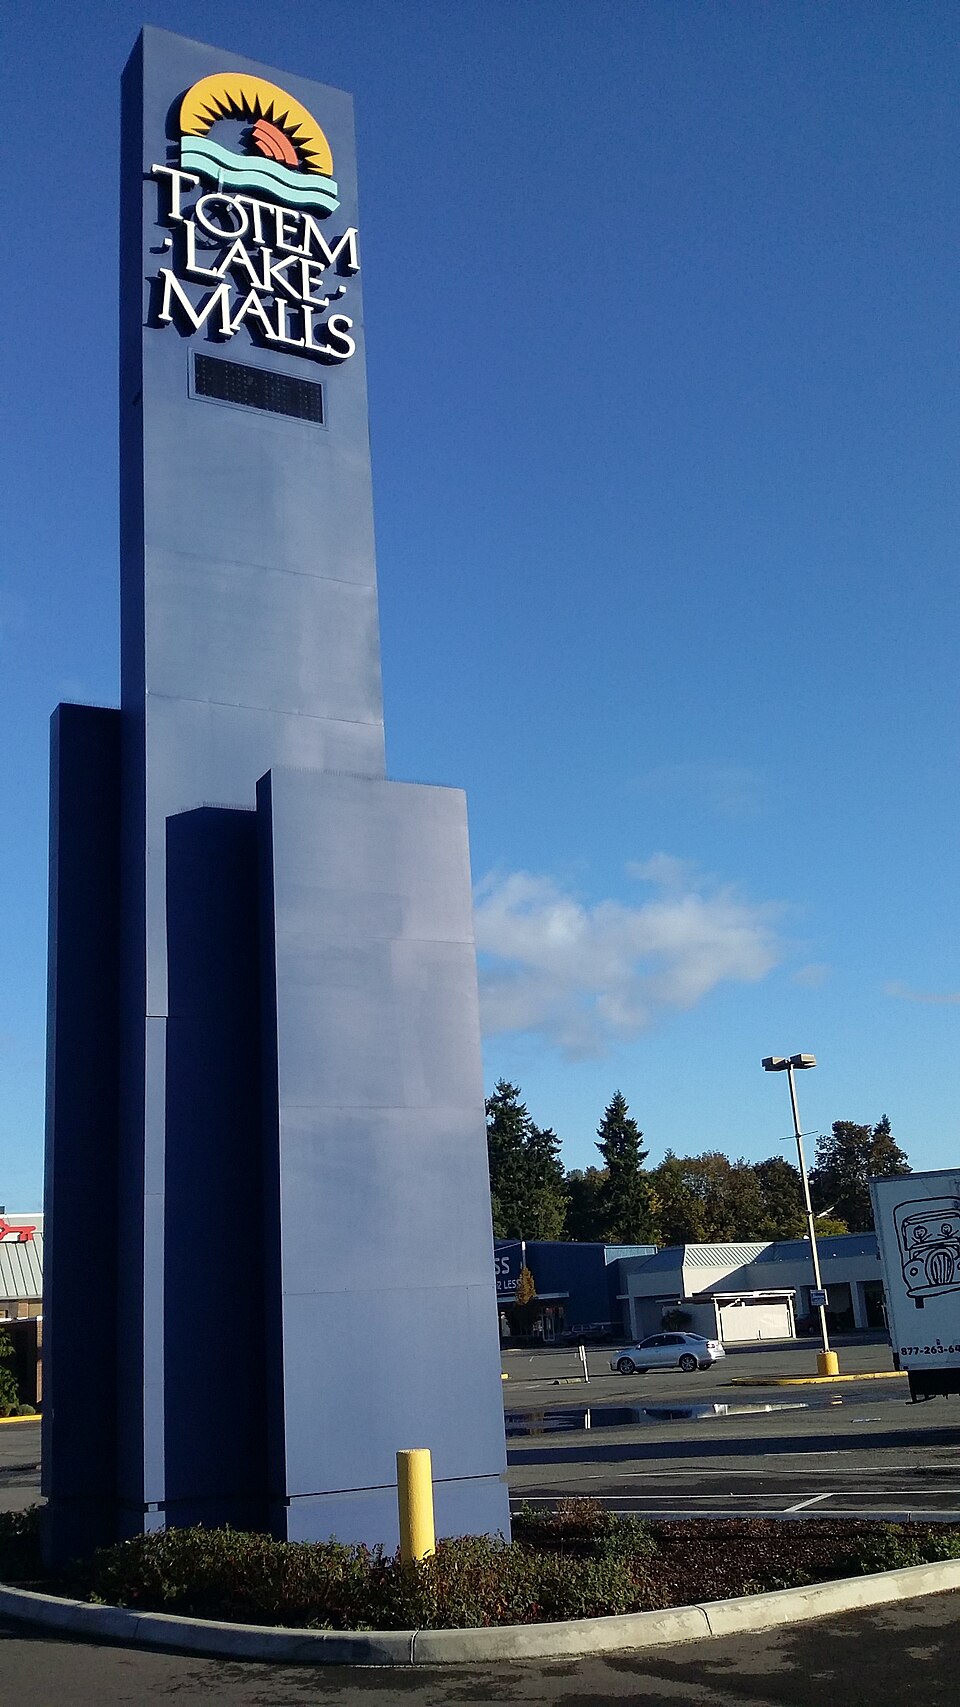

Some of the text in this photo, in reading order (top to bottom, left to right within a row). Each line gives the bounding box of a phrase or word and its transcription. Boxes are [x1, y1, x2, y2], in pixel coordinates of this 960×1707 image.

[152, 164, 360, 270] TOTEM
[184, 219, 329, 307] LAKE
[158, 268, 355, 359] MALLS
